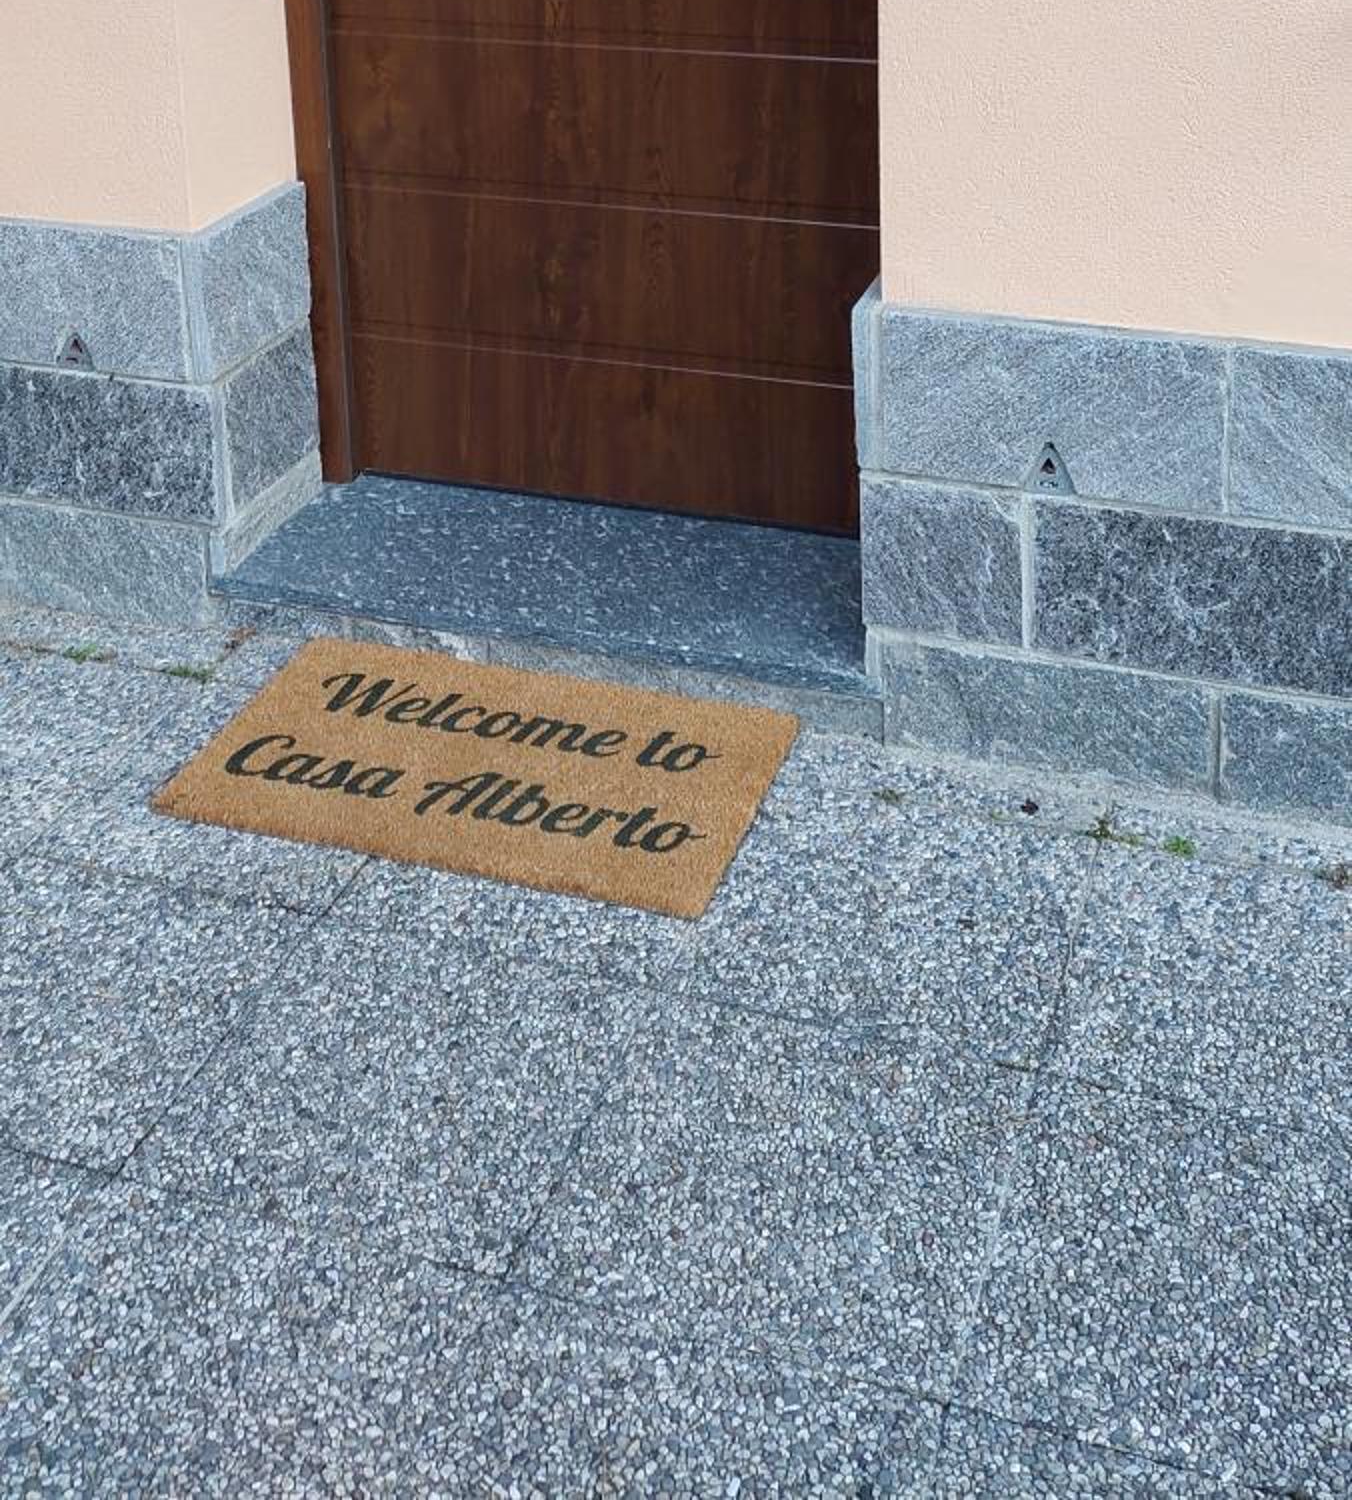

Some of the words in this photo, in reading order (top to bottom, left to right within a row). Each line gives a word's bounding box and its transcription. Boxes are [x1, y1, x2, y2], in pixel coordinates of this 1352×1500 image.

[321, 672, 627, 757] Welcome
[636, 730, 721, 773] to
[225, 733, 406, 798] Casa
[412, 770, 708, 854] Alberto
